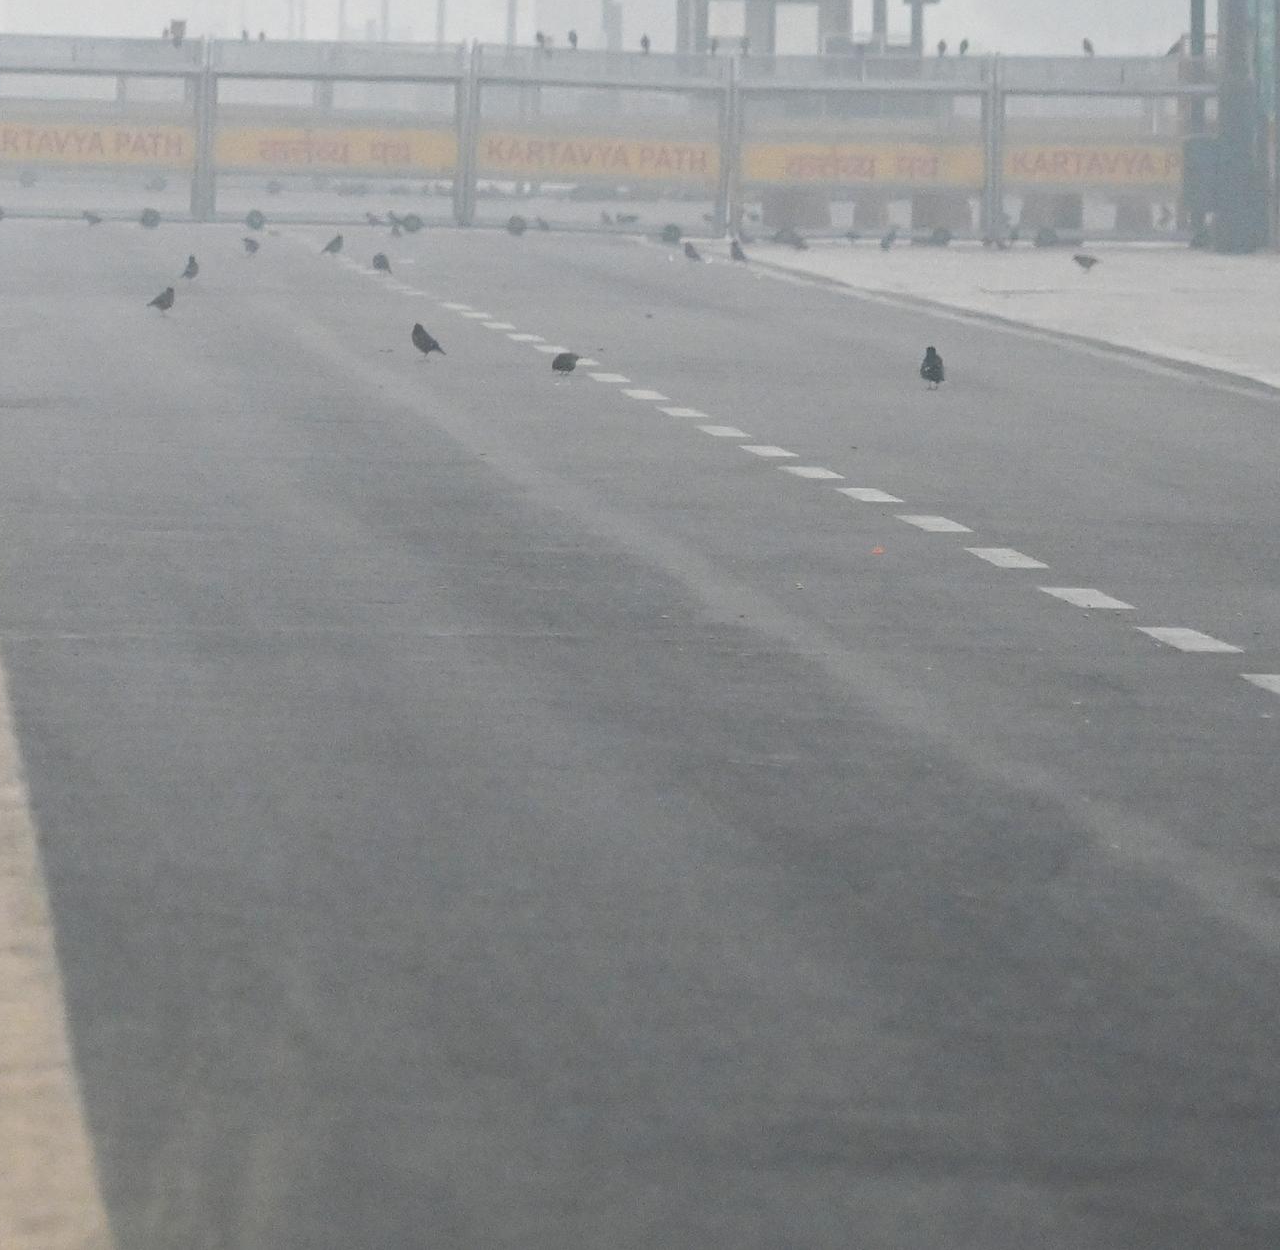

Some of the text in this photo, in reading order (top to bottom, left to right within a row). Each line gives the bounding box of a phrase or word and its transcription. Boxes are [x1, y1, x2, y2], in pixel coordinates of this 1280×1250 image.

[115, 131, 183, 157] PATH
[487, 139, 707, 171] KARTAVYA PATH
[1013, 151, 1153, 175] KARTAVYA
